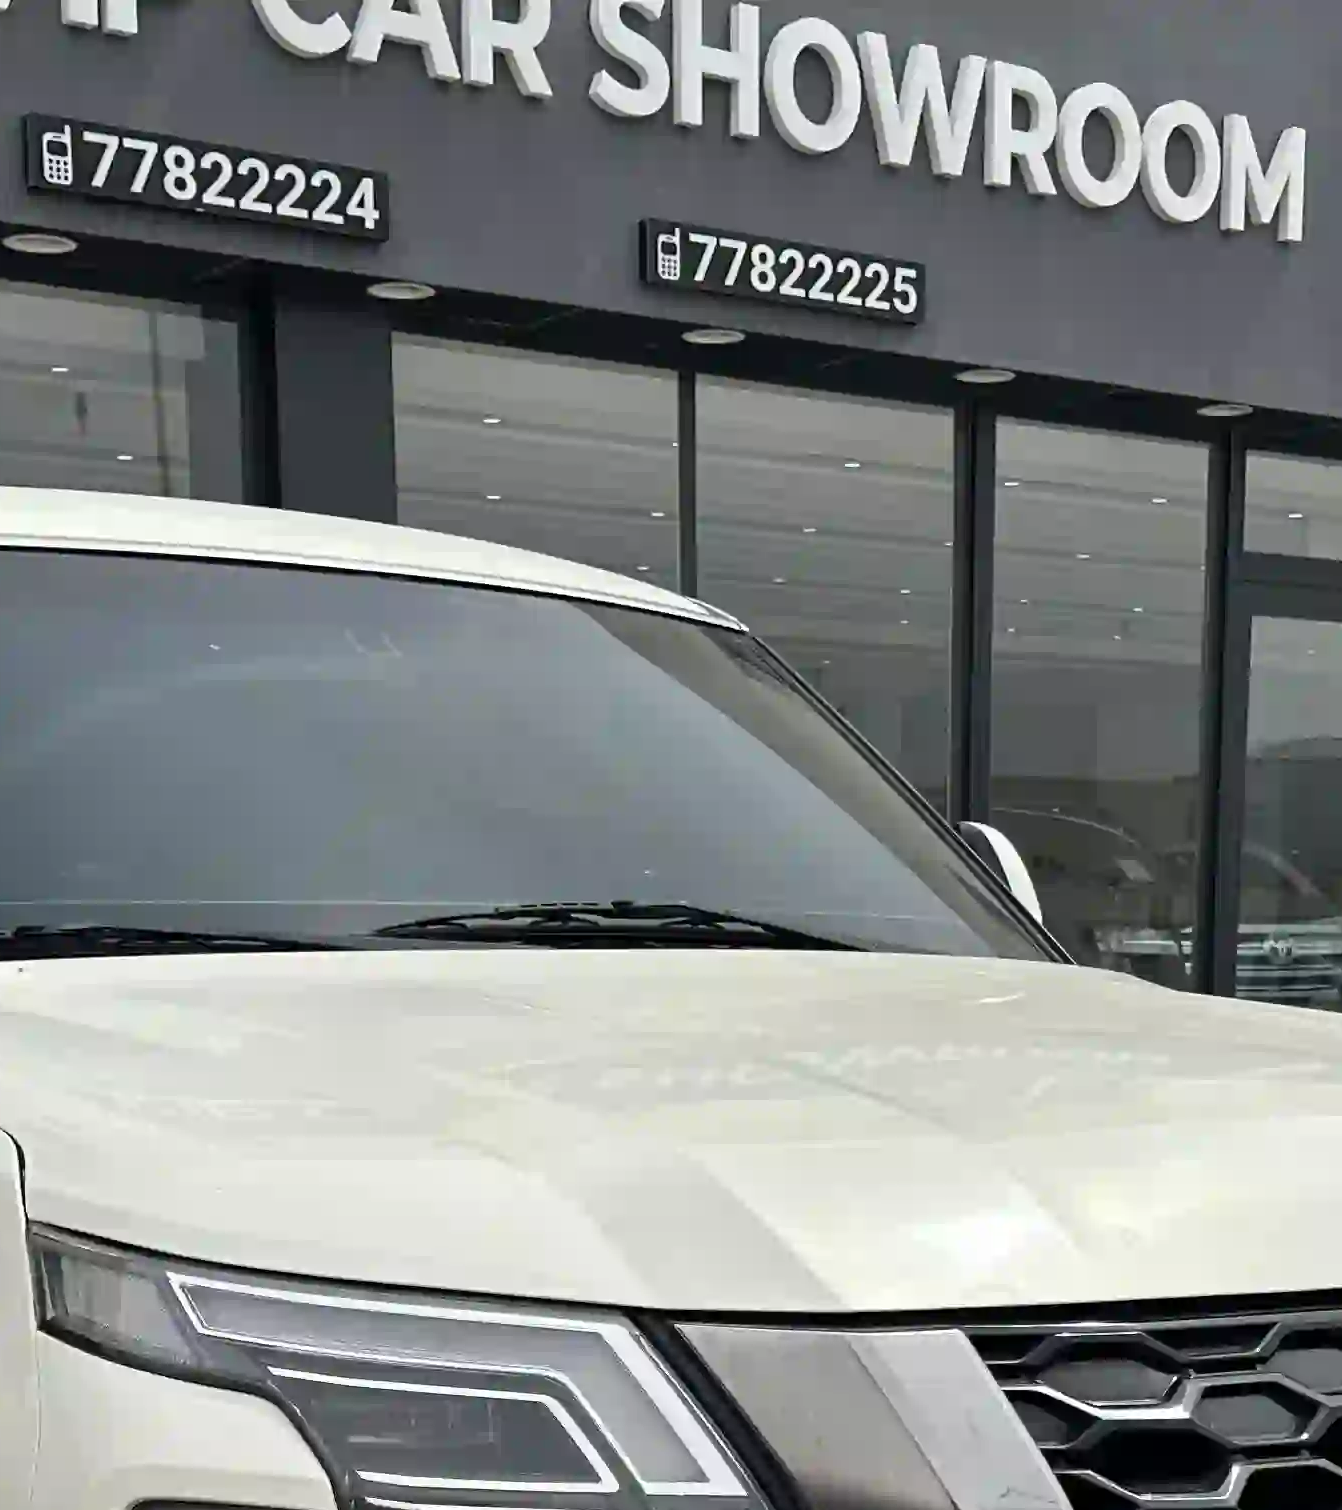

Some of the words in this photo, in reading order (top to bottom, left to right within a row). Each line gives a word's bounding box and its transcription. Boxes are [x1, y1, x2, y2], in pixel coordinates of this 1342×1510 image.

[588, 0, 1306, 243] SHOWROOM
[83, 131, 379, 232] 77822224
[688, 234, 920, 316] 77822225
